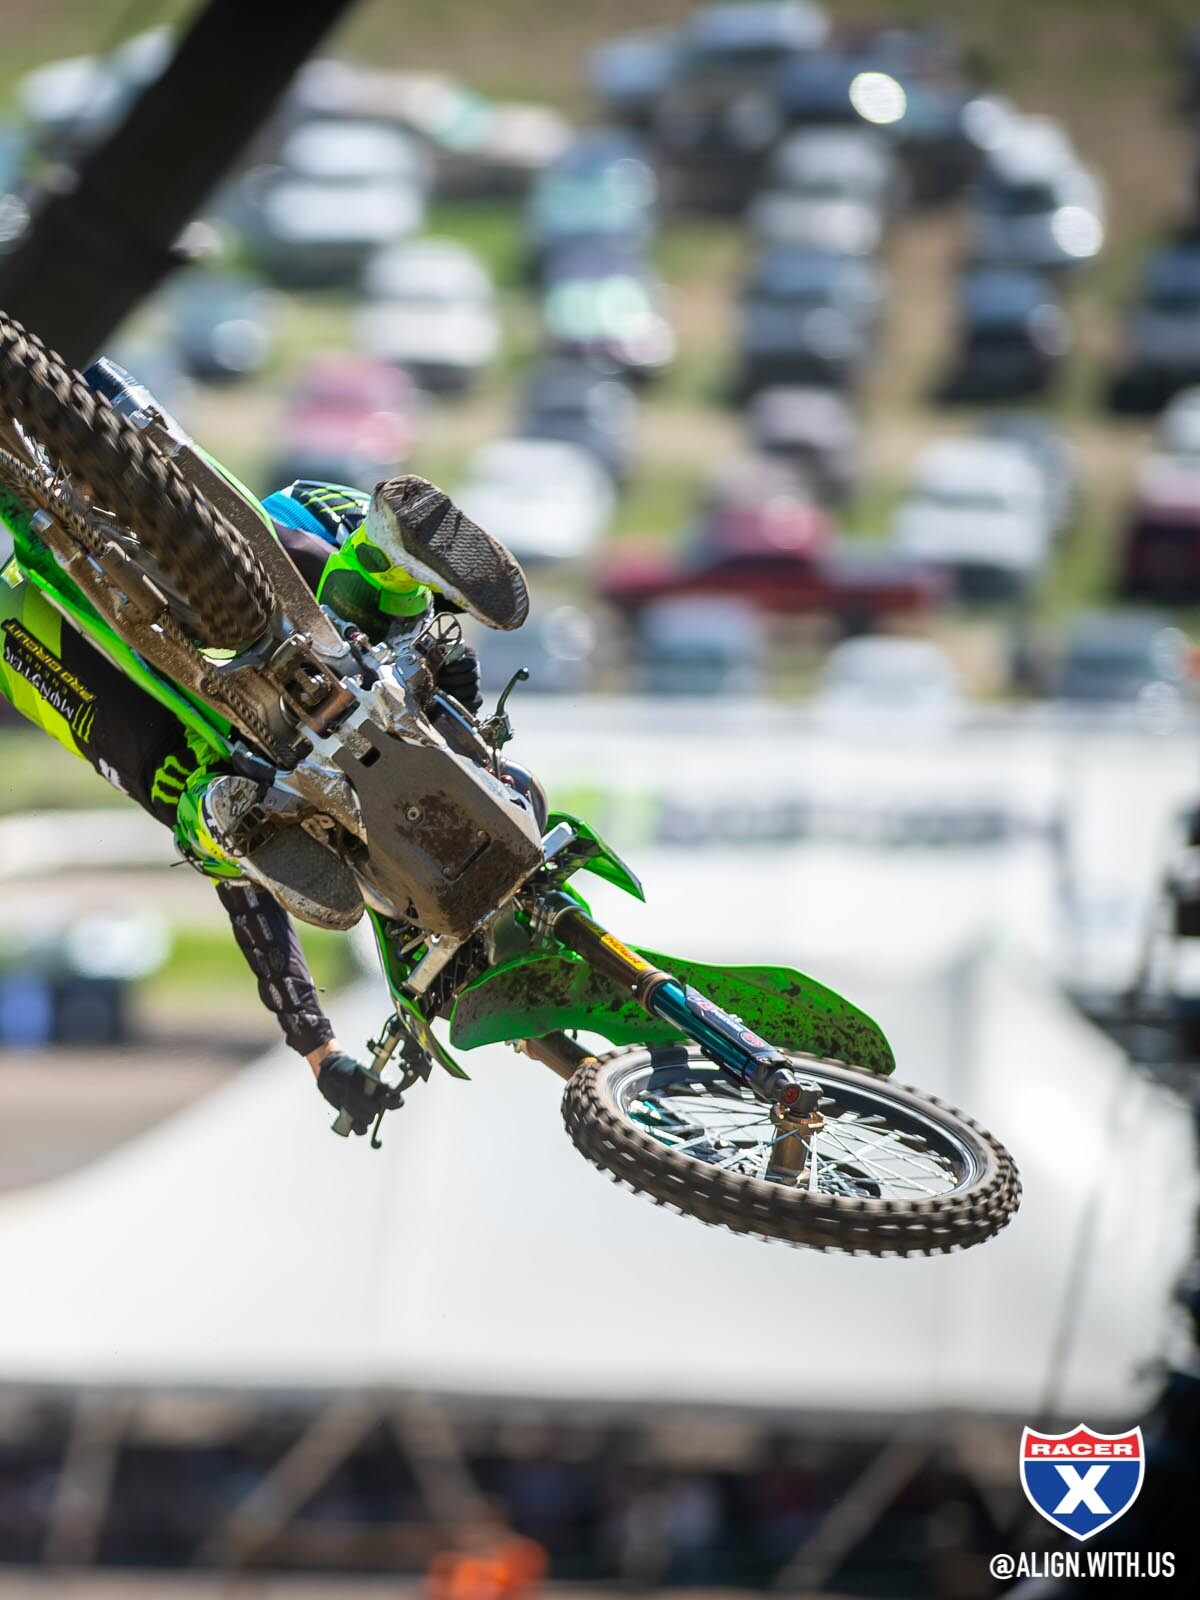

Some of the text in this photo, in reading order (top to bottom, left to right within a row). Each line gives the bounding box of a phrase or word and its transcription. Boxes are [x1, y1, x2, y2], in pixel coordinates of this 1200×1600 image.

[5, 646, 75, 719] MONSTER
[6, 622, 95, 702] PRO CIRCUIT
